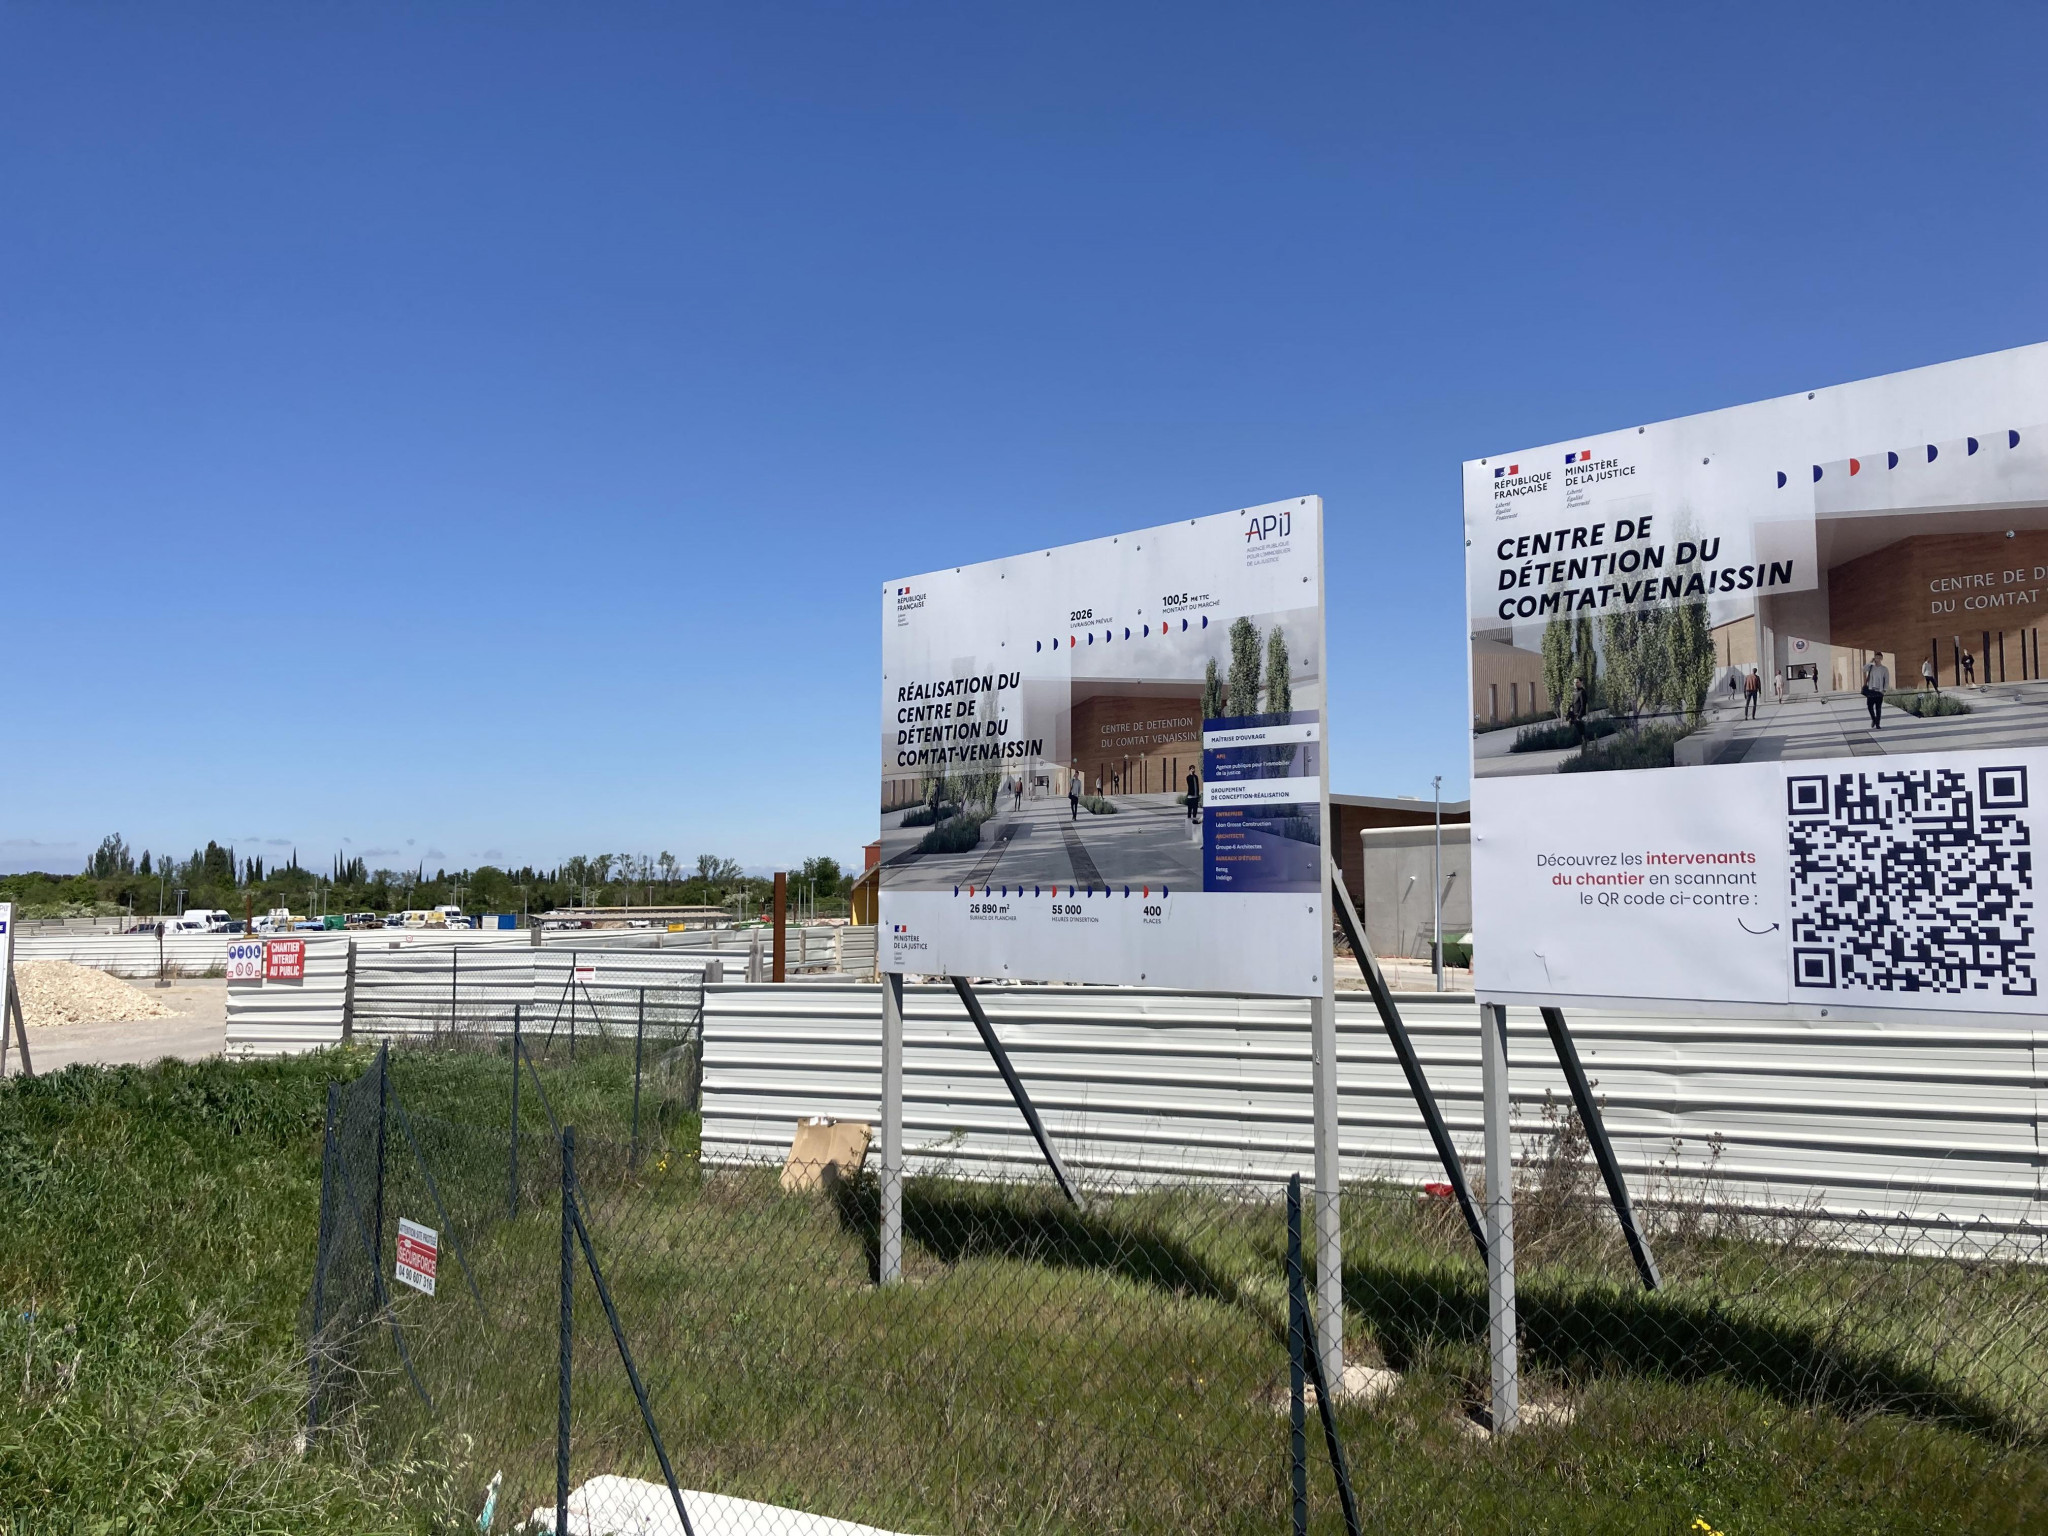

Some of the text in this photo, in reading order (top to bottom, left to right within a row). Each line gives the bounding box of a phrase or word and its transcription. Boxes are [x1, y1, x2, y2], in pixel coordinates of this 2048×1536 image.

[1565, 459, 1618, 476] MINISTÈRE
[1494, 471, 1552, 490] RÉPUBLIQUE
[1565, 466, 1636, 487] DE LA JUSTICE
[1494, 483, 1548, 500] FRANÇAISE
[1496, 515, 1653, 561] CENTRE DE
[1498, 537, 1721, 591] DÉTENTION DU
[1930, 572, 1996, 592] CENTRE
[2003, 569, 2026, 584] DE
[1498, 560, 1794, 621] COMTAT-VENAISSIN
[897, 593, 927, 605] RÉPUBLIQUE
[897, 601, 925, 611] FRANÇAISE
[1162, 593, 1188, 606] 100,5
[1162, 605, 1188, 614] MONTANT
[1198, 599, 1220, 608] MARCHÉ
[1931, 589, 2040, 614] DU COMTAT
[1070, 609, 1093, 621] 2026
[1070, 617, 1113, 629] LIVRAISON PRÉVUE
[897, 672, 1021, 702] RÉALISATION DU
[897, 700, 976, 724] CENTRE DE
[897, 719, 1009, 746] DÉTENTION DU
[1101, 717, 1193, 734] CENTRE DE DETENTION
[1101, 731, 1197, 748] DU COMTAT VENAISSIN
[1211, 733, 1266, 743] MAÎTRISE D'OUVRAGE
[897, 739, 1043, 767] COMTAT-VENAISSIN
[1211, 786, 1246, 794] GROUPEMENT
[1537, 850, 1756, 867] Découvrez les intervenants
[1552, 871, 1757, 886] du chantier en scannant
[1580, 892, 1593, 905] le
[1597, 892, 1619, 907] QR
[1623, 891, 1665, 905] code
[1669, 891, 1750, 905] ci-contre
[970, 903, 980, 913] 26
[982, 903, 998, 914] 890
[1052, 904, 1082, 915] 55 000
[1143, 905, 1162, 916] 400
[893, 934, 920, 942] MINISTÈRE
[908, 942, 928, 950] JUSTICE
[271, 942, 300, 953] CHANTIER
[271, 953, 299, 965] INTERDIT
[270, 966, 278, 976] AU
[280, 965, 300, 976] PUBLIC
[397, 1246, 436, 1276] SECURIFORCE
[398, 1265, 405, 1278] 04
[405, 1269, 413, 1281] 90
[422, 1276, 433, 1291] 316
